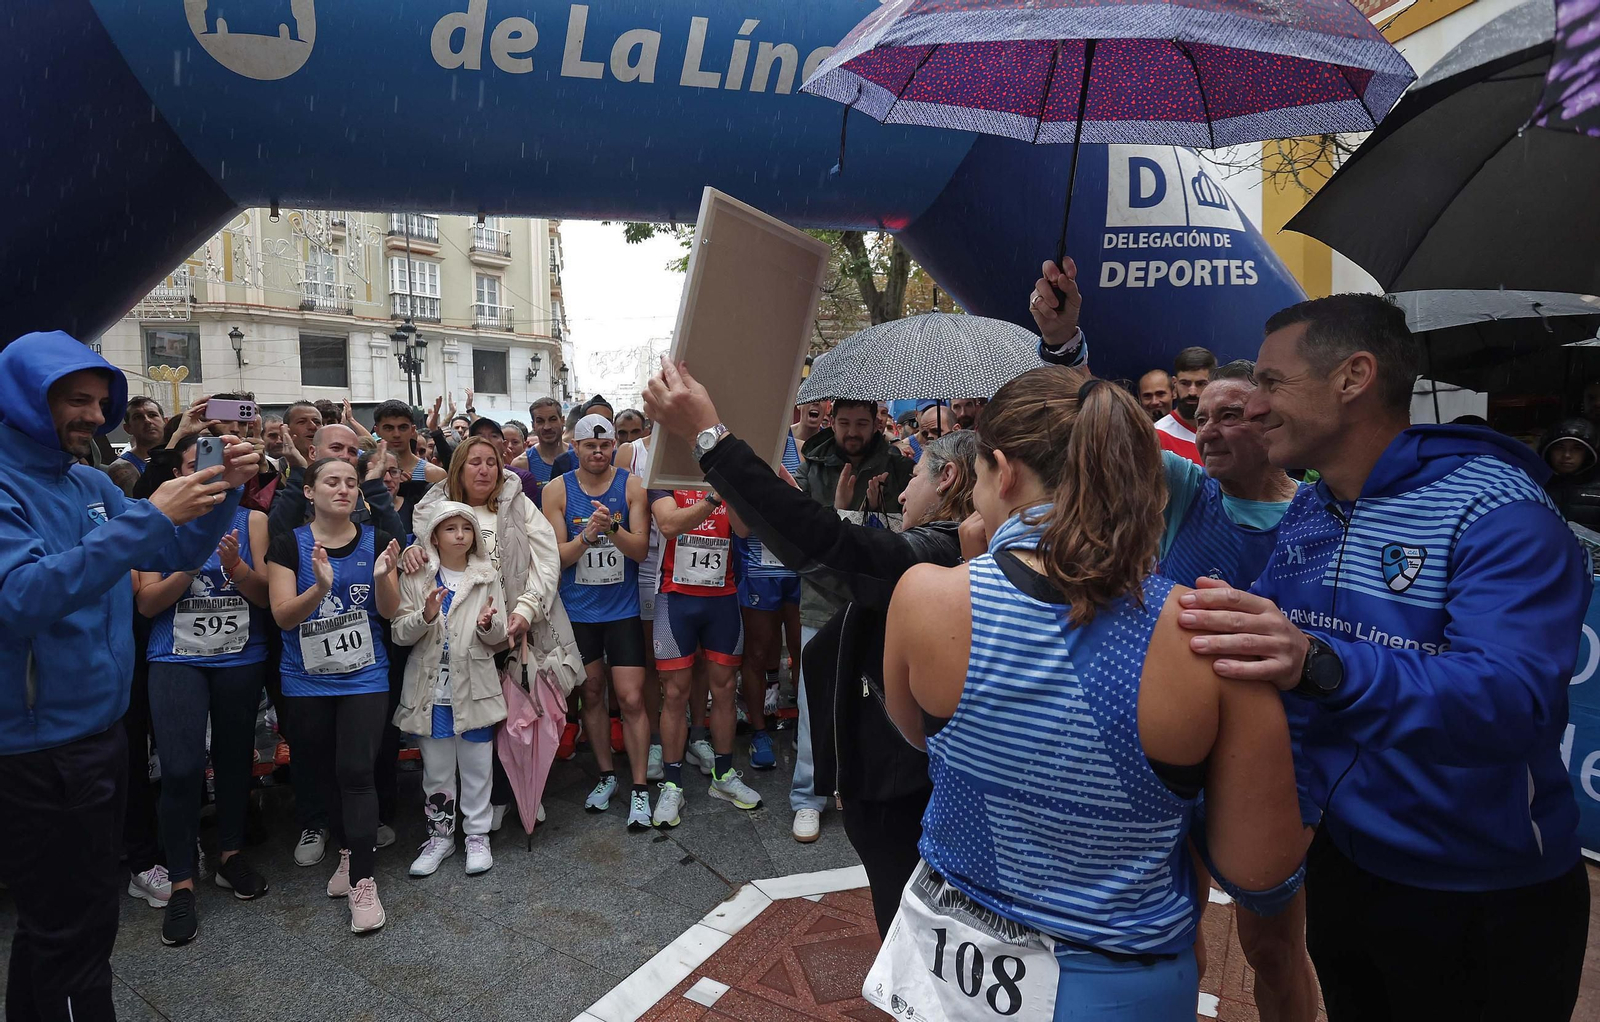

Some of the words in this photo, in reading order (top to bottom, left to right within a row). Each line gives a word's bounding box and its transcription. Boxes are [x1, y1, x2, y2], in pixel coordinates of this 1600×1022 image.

[430, 0, 539, 74] de
[560, 3, 661, 83] La
[1128, 156, 1167, 209] D
[1103, 229, 1211, 249] DELEGACIÓN
[1214, 234, 1232, 248] DE
[1099, 259, 1259, 288] DEPORTES
[586, 550, 617, 568] 116
[690, 551, 721, 570] 143
[193, 615, 239, 637] 595
[320, 629, 363, 657] 140
[928, 927, 1026, 1016] 108
